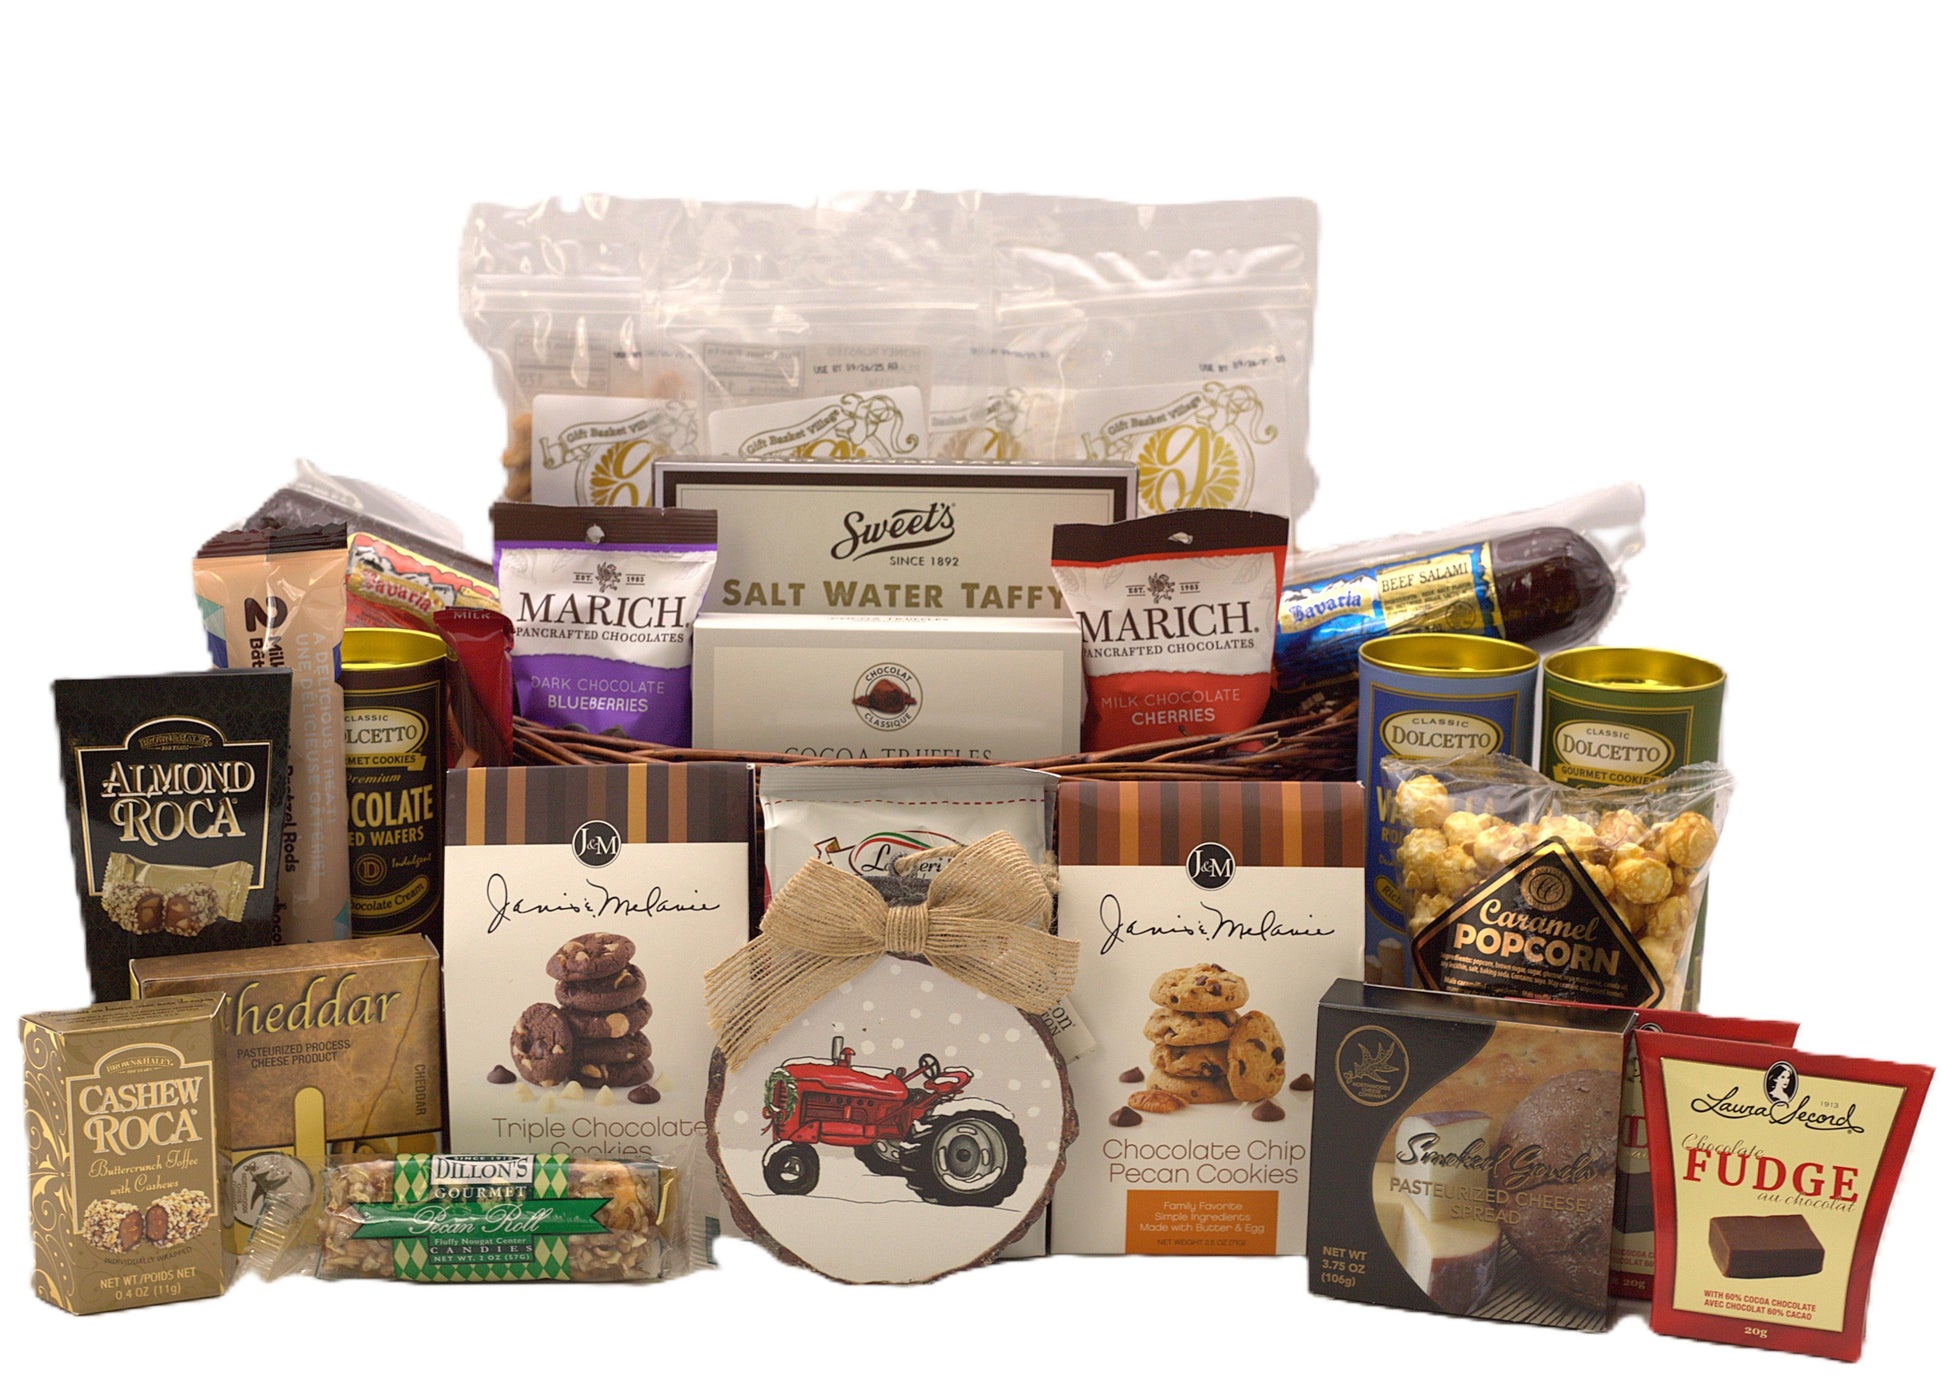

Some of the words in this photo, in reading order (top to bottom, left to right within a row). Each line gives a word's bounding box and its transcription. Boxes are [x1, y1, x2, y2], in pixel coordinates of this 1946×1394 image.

[830, 501, 955, 561] Sweet's
[889, 556, 925, 566] SINCE
[930, 556, 960, 567] 1892
[1381, 573, 1415, 593] BEEF
[1418, 562, 1469, 584] SALAMI
[722, 578, 806, 607] SALT
[822, 580, 945, 608] WATER
[960, 582, 1065, 610] TAFFY
[453, 611, 491, 620] MILK
[1289, 590, 1363, 623] Bavaria
[313, 632, 326, 644] A
[516, 626, 599, 641] PANCRAFTED
[602, 630, 685, 643] CHOCOLATES
[295, 633, 312, 672] UNE
[1166, 638, 1255, 654] CHOCOLATES
[531, 675, 571, 690] DARK
[577, 678, 665, 695] CHOCOLATE
[865, 666, 912, 682] CHOCOLAT
[315, 651, 334, 749] DELICIOUS
[547, 694, 649, 713] BLUEBERRIES
[1101, 694, 1139, 709] MILK
[1144, 688, 1241, 707] CHOCOLATE
[864, 712, 912, 729] CLASSIQUE
[1131, 708, 1216, 726] CHERRIES
[1412, 716, 1469, 728] CLASSIC
[344, 724, 418, 744] LCETTO
[1390, 725, 1492, 750] DOLCETTO
[1586, 727, 1630, 740] CLASSIC
[372, 754, 417, 765] COOKIES
[1560, 734, 1661, 763] DOLCETTO
[101, 761, 256, 798] ALMOND
[1561, 765, 1607, 780] GOURMET
[109, 797, 247, 847] ROCA
[370, 825, 425, 847] WAFERS
[577, 826, 619, 858] J&M
[282, 831, 299, 873] Rods
[1191, 849, 1234, 879] J&M
[394, 882, 425, 906] Cream
[1479, 898, 1600, 942] Caramel
[1453, 922, 1621, 977] POPCORN
[232, 972, 402, 1037] heddar
[237, 1043, 303, 1059] PASTEURIZED
[305, 1039, 351, 1053] PROCESS
[251, 1056, 290, 1069] CHEESE
[292, 1052, 338, 1066] PRODUCT
[79, 1076, 204, 1116] CASHEW
[414, 1064, 427, 1117] CHEDDAR
[1691, 1086, 1771, 1120] Laura
[1769, 1095, 1865, 1134] Secord
[1820, 1101, 1840, 1109] 1913
[83, 1107, 204, 1156] ROCA
[491, 1117, 565, 1143] Triple
[572, 1115, 709, 1138] Chocolate
[1102, 1138, 1241, 1161] Chocolate
[1247, 1138, 1307, 1165] Chip
[1681, 1133, 1764, 1159] Chocolate
[88, 1154, 163, 1178] Buttercrunch
[165, 1147, 199, 1170] Toffee
[435, 1157, 529, 1180] DILLON'S
[1396, 1132, 1514, 1178] Smoked
[1503, 1143, 1599, 1190] Gouda
[1109, 1163, 1190, 1184] Pecan
[1196, 1162, 1299, 1184] Cookies
[1682, 1146, 1859, 1203] FUDGE
[110, 1178, 131, 1196] with
[133, 1173, 179, 1193] Cashews
[434, 1185, 528, 1199] GOURMET
[1389, 1176, 1510, 1205] PASTEURIZED
[1515, 1191, 1588, 1213] CHEESE
[1163, 1201, 1197, 1213] Family
[1199, 1201, 1243, 1211] Favorite
[1757, 1191, 1780, 1202] au
[1784, 1193, 1857, 1213] chocolat
[408, 1204, 476, 1235] Pecan
[481, 1203, 554, 1233] Roll
[1154, 1211, 1189, 1223] Simple
[1190, 1211, 1251, 1222] Ingredients
[1450, 1204, 1522, 1225] SPREAD
[1139, 1223, 1169, 1232] Made
[1171, 1223, 1193, 1232] with
[1195, 1223, 1233, 1233] Butter
[1234, 1224, 1242, 1233] &
[1244, 1223, 1266, 1235] Egg
[430, 1244, 533, 1255] CANDIES
[434, 1237, 459, 1246] Fluffy
[461, 1237, 495, 1247] Nougat
[496, 1237, 527, 1245] Center
[1157, 1238, 1173, 1246] NET
[1217, 1238, 1228, 1246] OZ
[1322, 1245, 1347, 1258] NET
[1348, 1249, 1368, 1261] WT
[434, 1255, 453, 1263] NET
[455, 1254, 476, 1262] WT.
[504, 1253, 531, 1262] (57G)
[1321, 1258, 1346, 1271] 3.75
[1348, 1263, 1366, 1275] OZ
[100, 1277, 121, 1290] NET
[176, 1266, 197, 1279] NET
[1320, 1271, 1356, 1288] (106g)
[1623, 1279, 1646, 1291] 20g
[115, 1289, 132, 1300] 0.4
[135, 1286, 150, 1298] OZ
[153, 1281, 182, 1298] (11g)
[1704, 1290, 1724, 1300] WITH
[1725, 1291, 1742, 1302] 60%
[1744, 1294, 1770, 1306] COCOA
[1771, 1298, 1817, 1313] CHOCOLATE
[1704, 1299, 1725, 1309] AVEC
[1726, 1301, 1766, 1315] CHOCOLAT
[1767, 1306, 1785, 1317] 60%
[1785, 1308, 1813, 1321] CACAO
[1744, 1326, 1768, 1339] 20g
